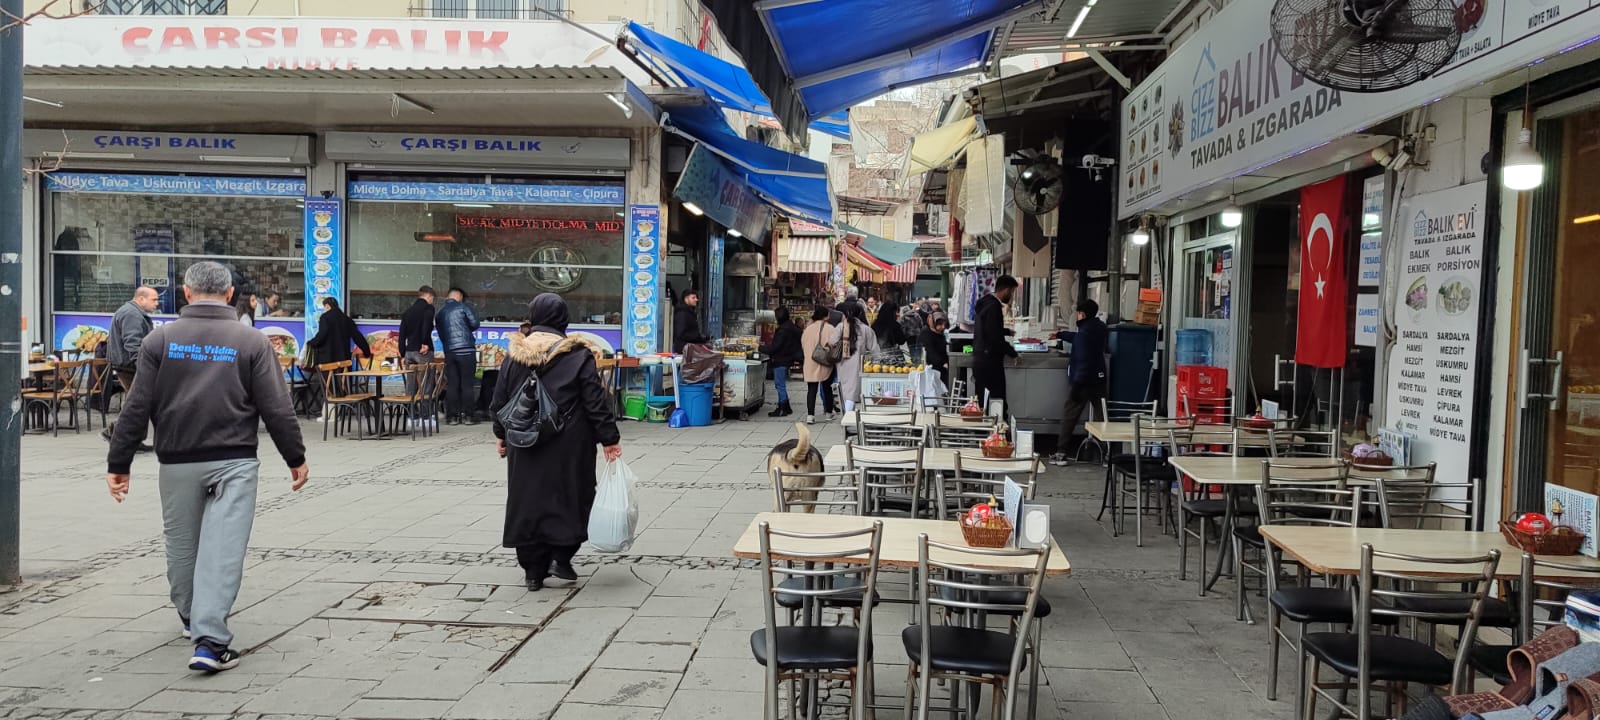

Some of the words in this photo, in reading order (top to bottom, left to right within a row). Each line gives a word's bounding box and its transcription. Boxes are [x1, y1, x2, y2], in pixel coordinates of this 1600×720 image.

[320, 27, 509, 60] BALIK
[1217, 37, 1280, 129] BALIK
[1190, 133, 1232, 169] TAVADA
[1237, 127, 1246, 151] &
[1250, 87, 1342, 146] IZGARADA
[94, 135, 161, 149] ÇARŞI
[168, 137, 236, 149] BALIK
[400, 137, 467, 151] ÇARŞI
[474, 140, 542, 151] BALIK
[54, 175, 96, 189] Midye
[101, 177, 129, 187] Tava
[143, 178, 201, 188] Uskumru
[353, 184, 388, 196] Midye
[391, 185, 426, 195] Dolma
[438, 186, 486, 198] Sardalya
[490, 187, 514, 196] Tava
[525, 188, 571, 197] Kalamar
[542, 219, 588, 230] DOLMA
[1427, 215, 1455, 236] BALIK
[1457, 206, 1475, 231] EVİ
[1442, 231, 1476, 242] IZGARADA
[1409, 249, 1431, 260] BALIK
[1445, 244, 1472, 256] BALIK
[1407, 263, 1432, 274] EKMEK
[1436, 258, 1480, 272] PORSİYON
[142, 278, 169, 286] PEPSI
[1402, 330, 1428, 340] SARDALYA
[1436, 331, 1470, 342] SARDALYA
[169, 342, 202, 354] Deniz
[1406, 343, 1423, 353] HAMSİ
[1440, 345, 1465, 356] MEZGİT
[1404, 356, 1424, 366] MEZGİT
[1435, 360, 1469, 371] USKUMRU
[1401, 369, 1426, 380] KALAMAR
[1440, 373, 1462, 385] HAMSİ
[1436, 387, 1463, 399] LEVREK
[1399, 395, 1425, 407] USKUMRU
[1436, 400, 1461, 413] ÇİPURA
[1401, 408, 1421, 419] LEVREK
[1433, 414, 1464, 428] KALAMAR
[1449, 431, 1466, 443] TAVA
